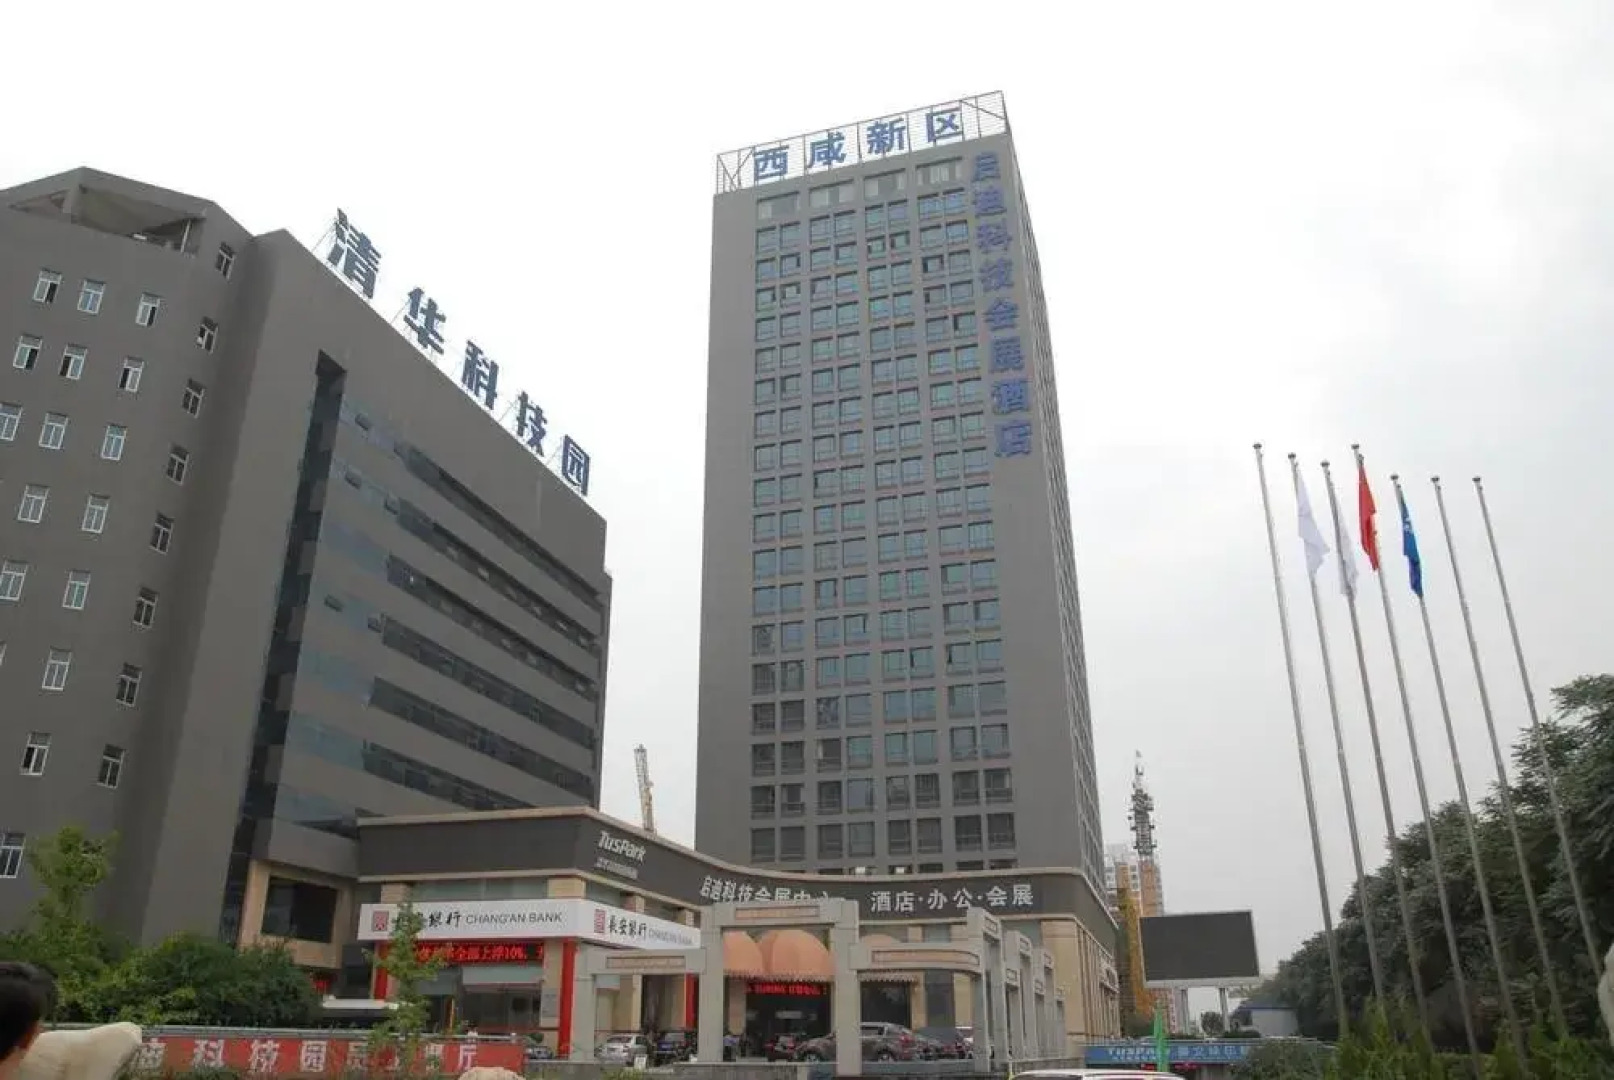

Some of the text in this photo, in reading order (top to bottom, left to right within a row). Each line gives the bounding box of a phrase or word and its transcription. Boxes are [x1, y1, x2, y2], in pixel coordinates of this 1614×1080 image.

[753, 106, 964, 181] 西咸新区
[327, 208, 590, 496] 清华科技园
[465, 911, 526, 925] CHANG'AN
[529, 912, 562, 923] BANK
